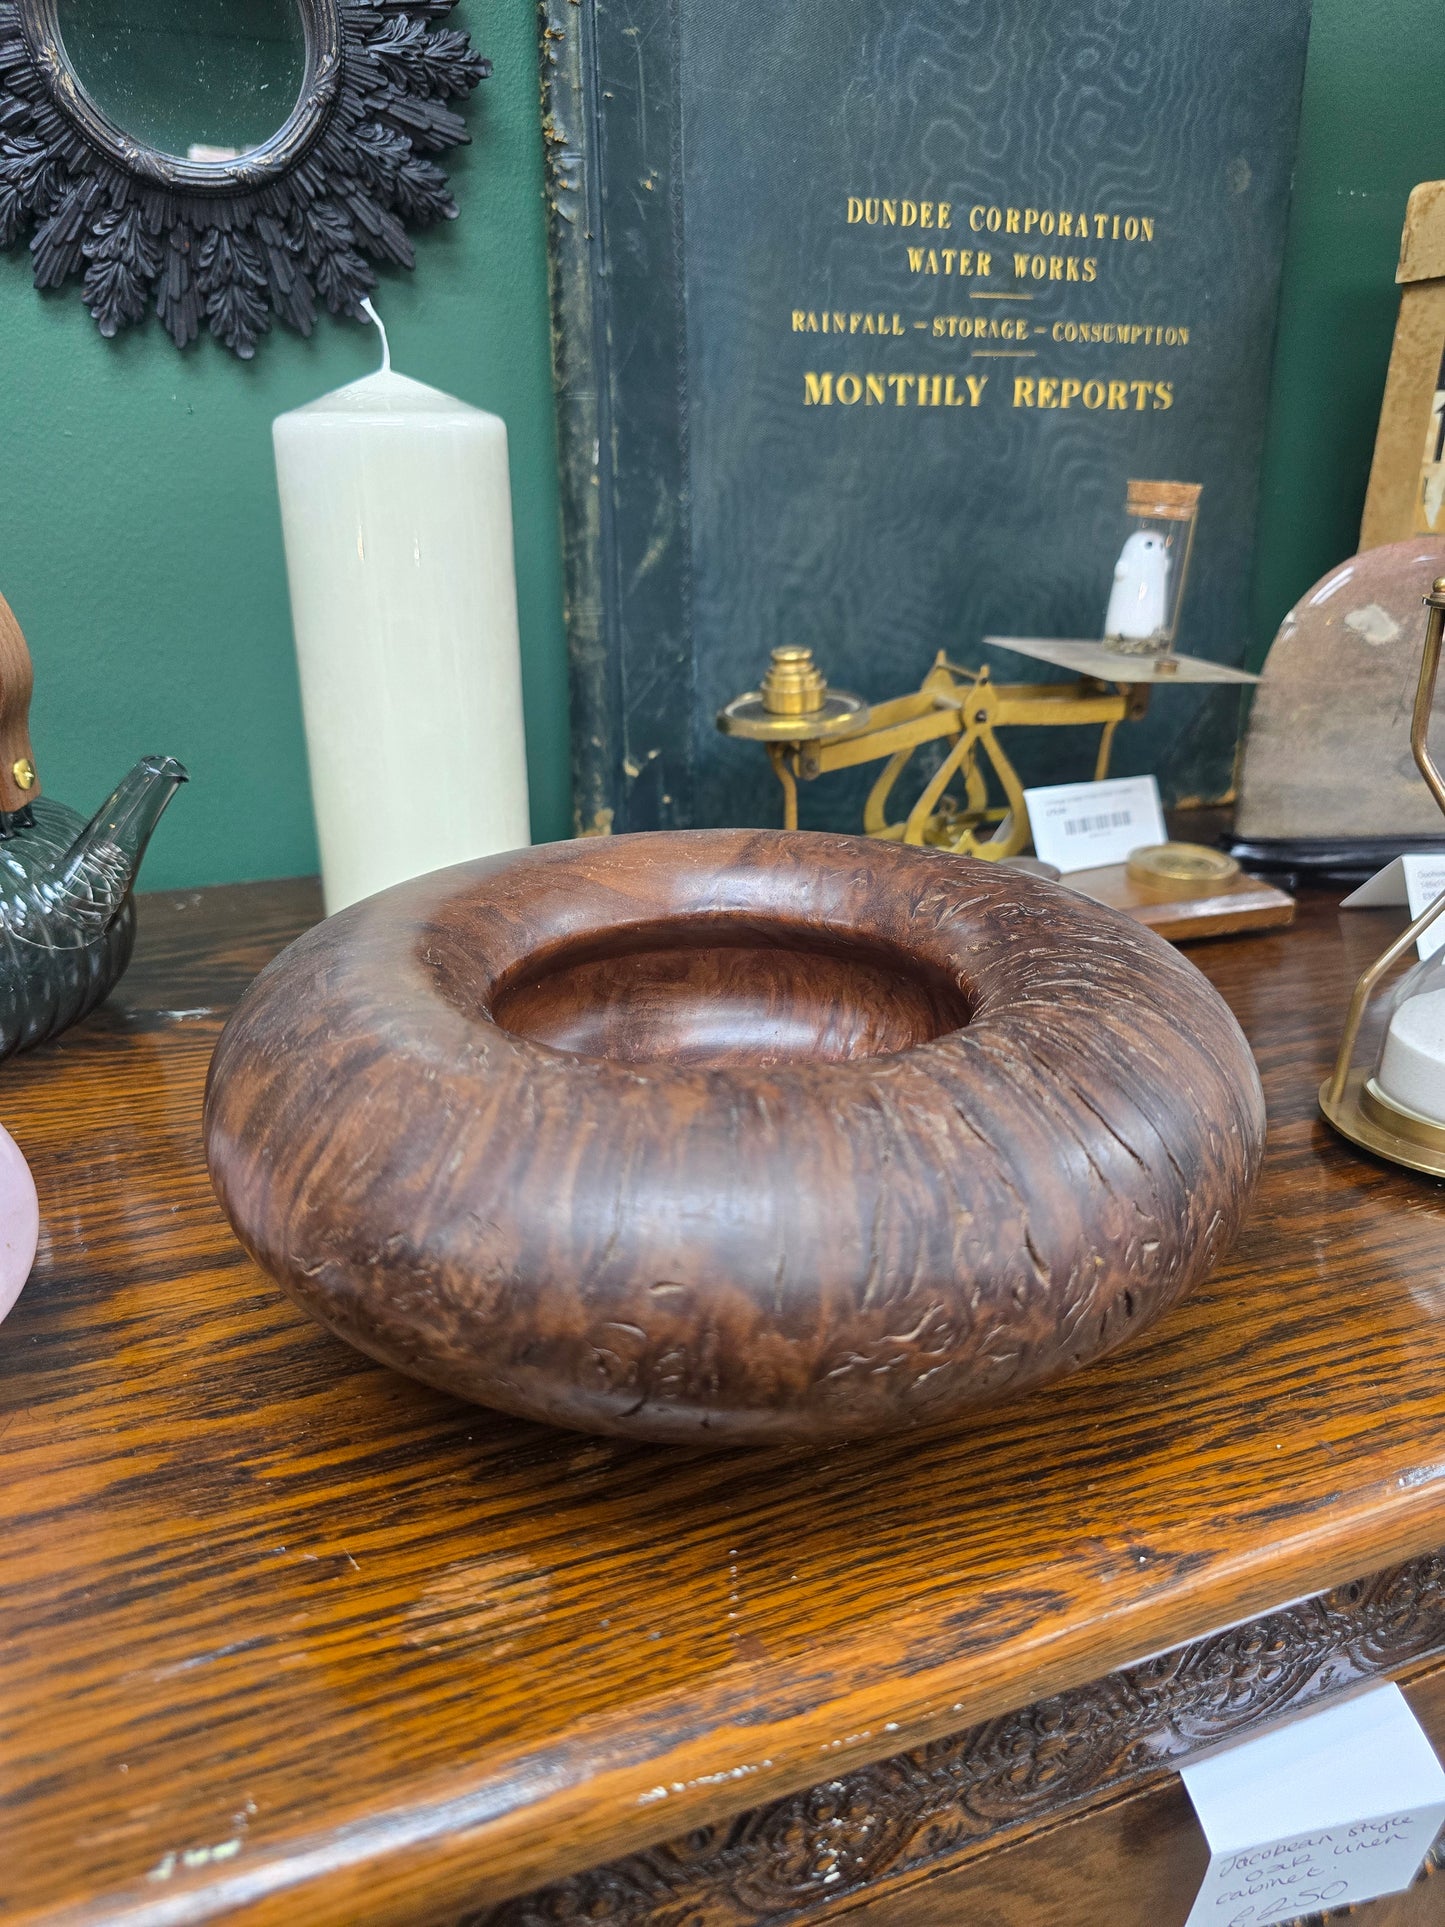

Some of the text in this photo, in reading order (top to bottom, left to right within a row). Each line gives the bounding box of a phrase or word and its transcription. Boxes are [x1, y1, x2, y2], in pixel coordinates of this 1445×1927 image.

[847, 196, 1155, 242] DUNDEE CORPORATION
[906, 246, 1098, 283] WATER WORKS
[792, 308, 906, 336] RAINFALL
[932, 313, 1030, 341] STORAGE
[1052, 319, 1190, 346] CONSUMPTION
[803, 370, 1174, 412] MONTHLY REPORTS
[1219, 1834, 1334, 1878] Jacobean
